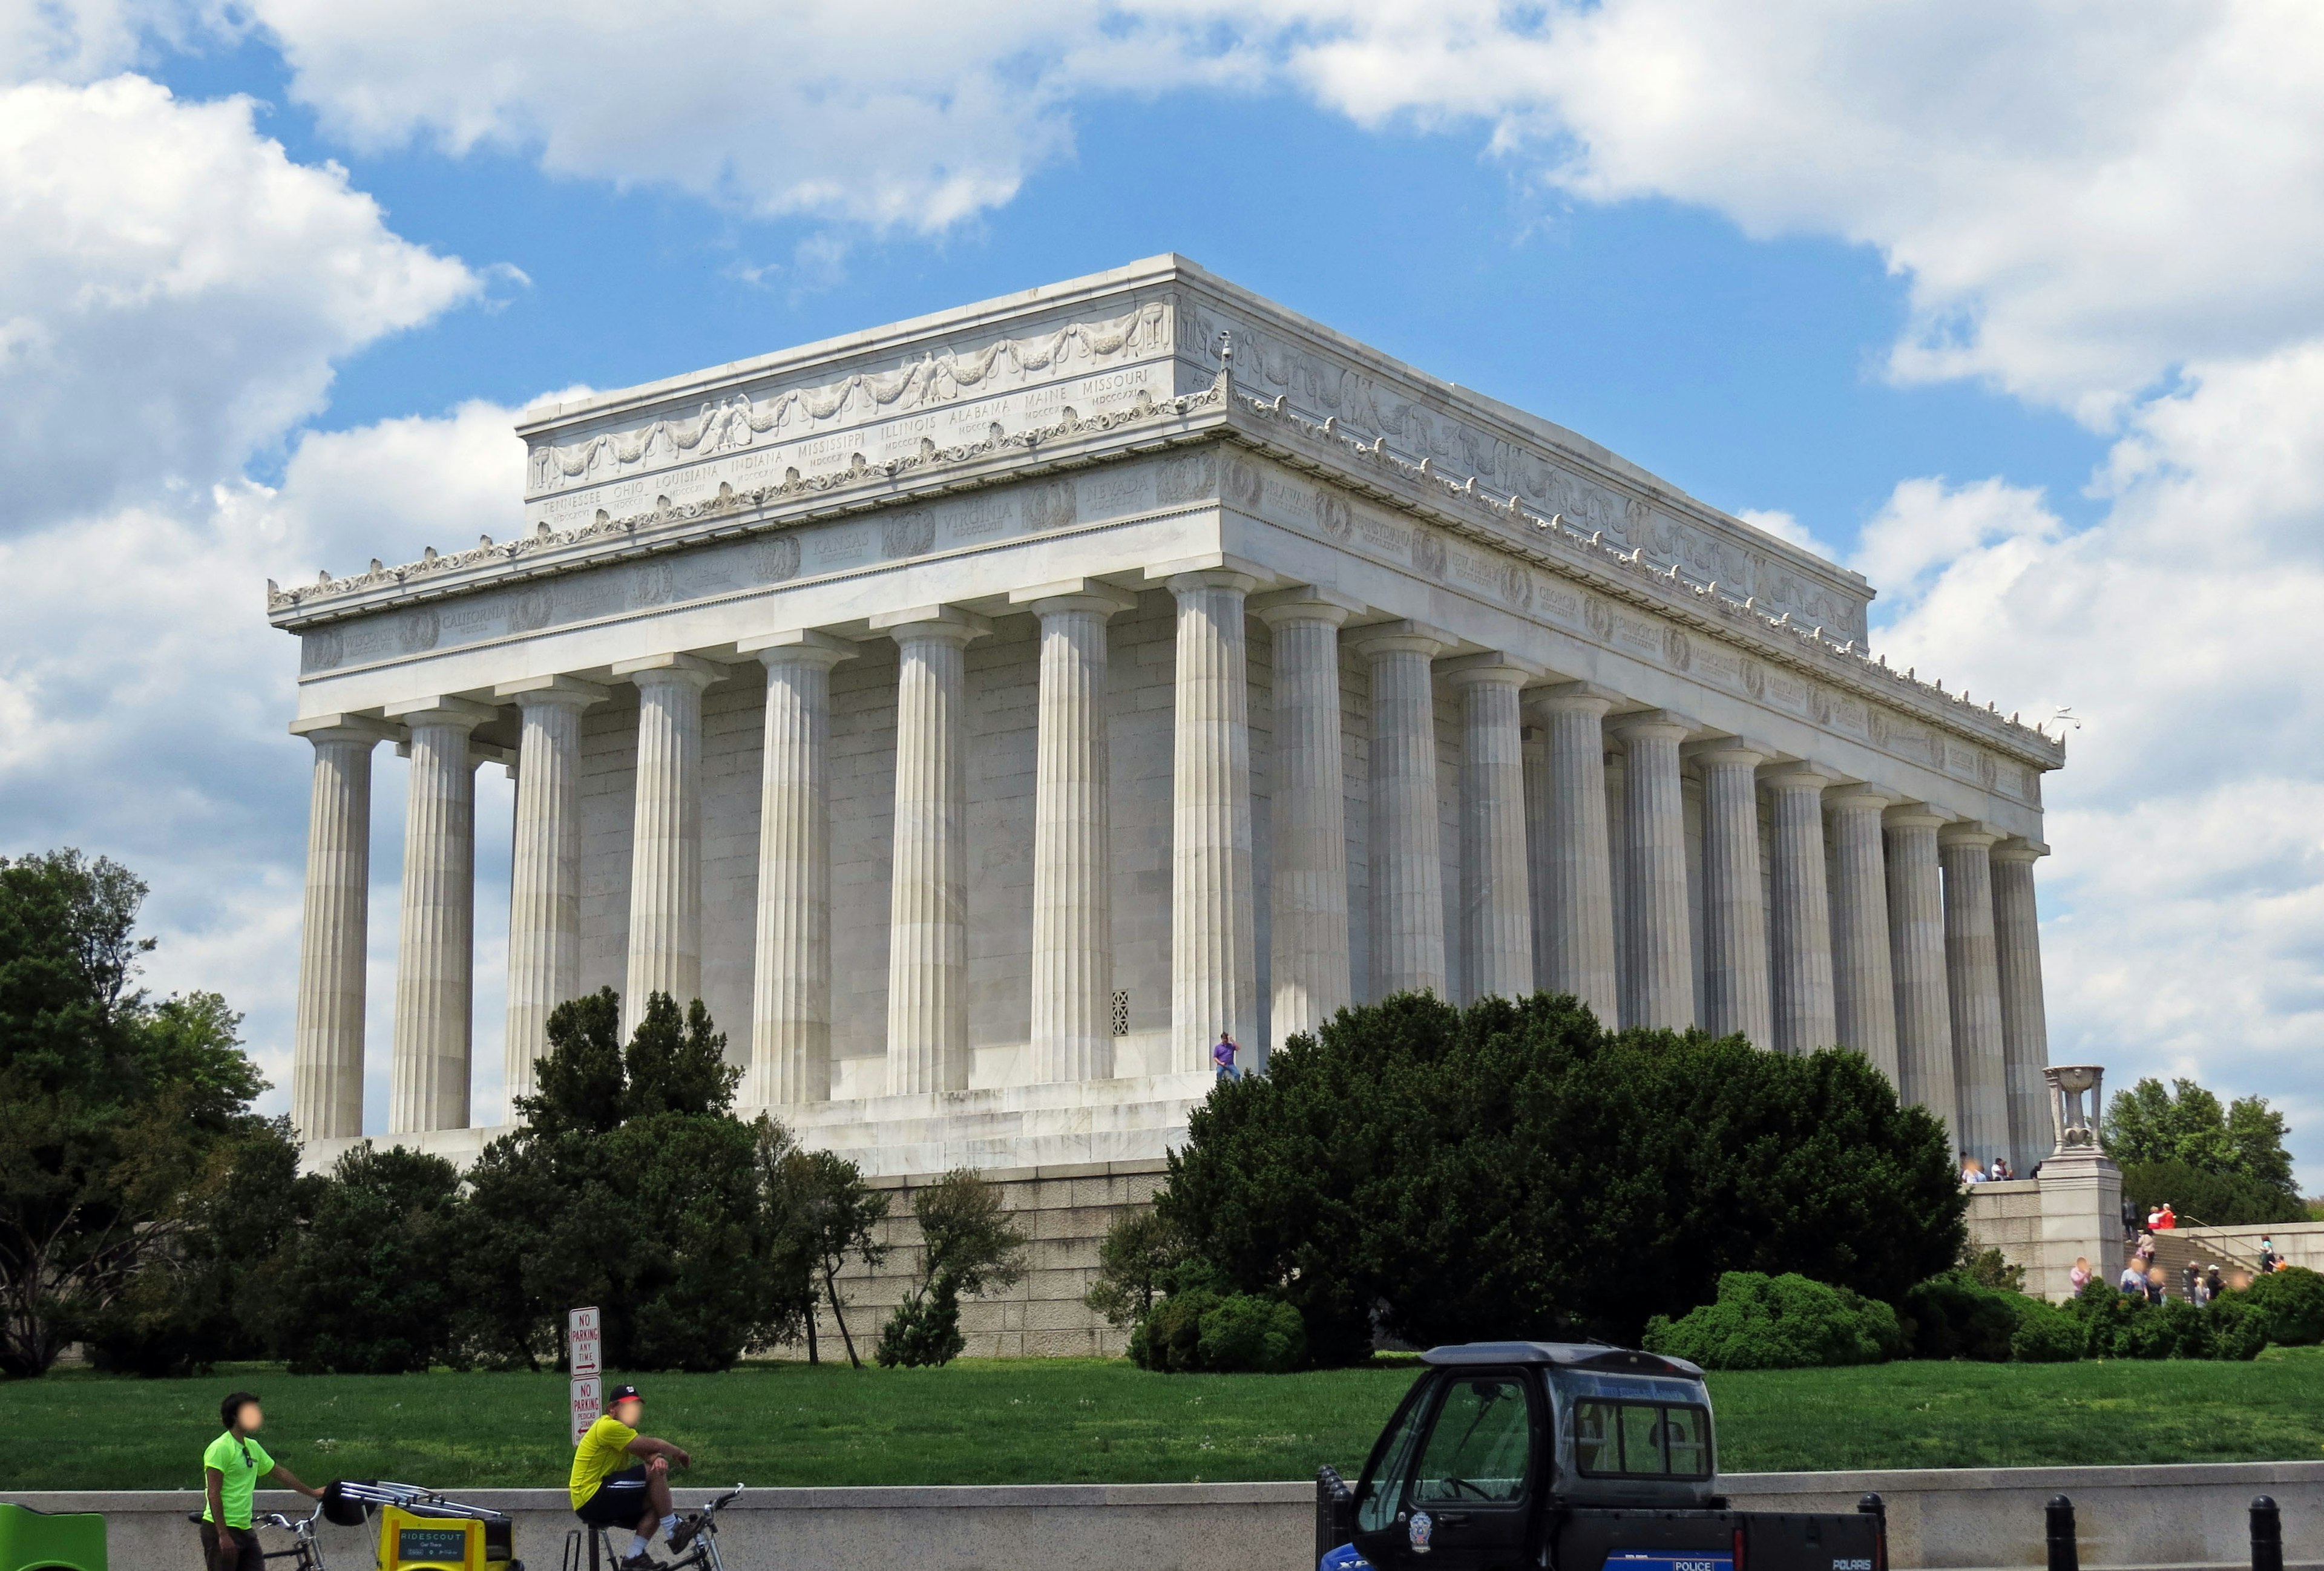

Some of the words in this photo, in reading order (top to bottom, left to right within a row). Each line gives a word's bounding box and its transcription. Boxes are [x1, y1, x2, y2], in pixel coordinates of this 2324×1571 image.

[1083, 369, 1148, 395] MISSOURI
[1025, 387, 1066, 408] MAINE
[1092, 389, 1138, 405] MDCCCXXI
[949, 401, 1011, 425] ALABAMA
[881, 416, 936, 440] ILLINOIS
[798, 433, 865, 458] MISSISSIPPI
[732, 451, 783, 473] INDIANA
[655, 465, 718, 488] LOUISIANA
[614, 482, 644, 497] OHIO
[1086, 474, 1149, 502] NEVADA
[543, 491, 601, 514] TENNESSEE
[944, 503, 1013, 531] VIRGINIA
[813, 530, 869, 555] KANSAS
[442, 605, 507, 629] CALIFORNIA
[579, 1315, 590, 1327] NO
[573, 1328, 598, 1342] PARKING
[580, 1342, 591, 1351] ANY
[579, 1353, 593, 1362] TIME
[581, 1385, 591, 1397] NO
[574, 1398, 599, 1412] PARKING
[1676, 1562, 1711, 1571] POLICE
[1833, 1559, 1871, 1570] POLARIS
